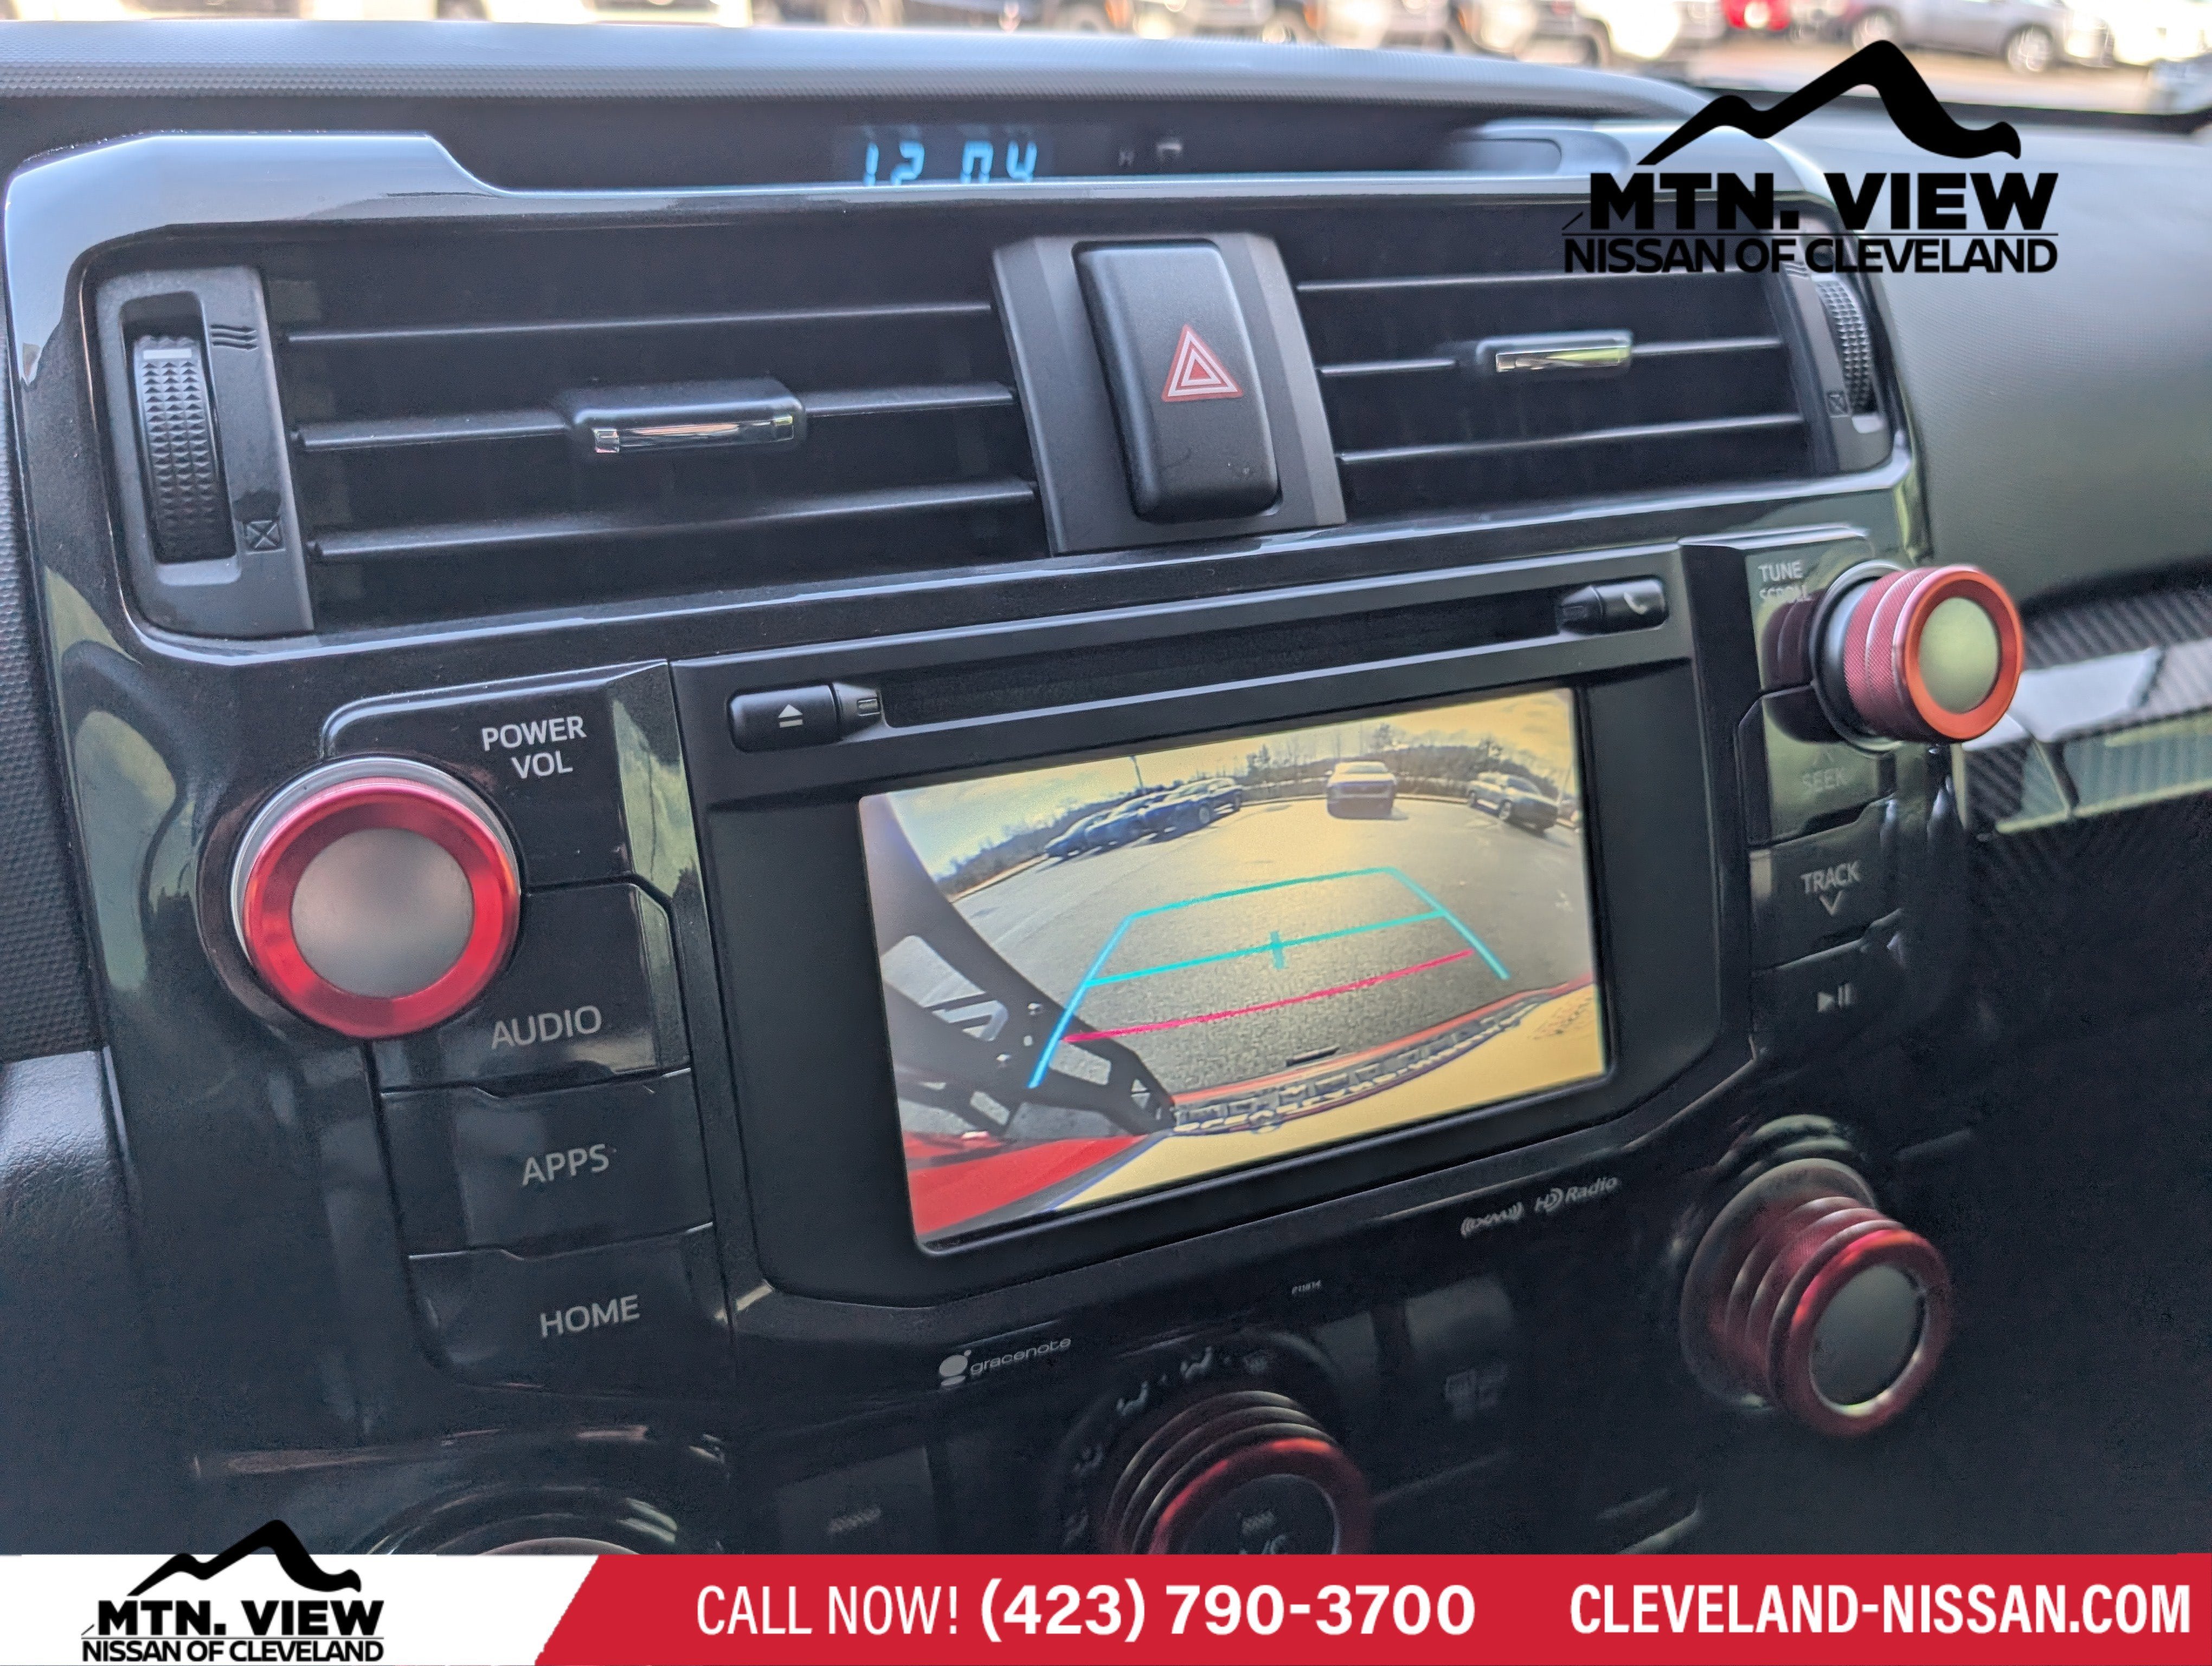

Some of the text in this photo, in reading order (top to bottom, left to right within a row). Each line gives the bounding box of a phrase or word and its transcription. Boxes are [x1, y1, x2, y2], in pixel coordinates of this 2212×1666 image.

[1758, 560, 1803, 582] TUNE
[481, 715, 587, 751] POWER
[512, 752, 573, 779] VOL
[1801, 861, 1861, 895] TRACK
[491, 1005, 602, 1049] AUDIO
[522, 1143, 610, 1187] APPS
[1565, 1176, 1618, 1203] Radio
[539, 1295, 641, 1338] HOME
[970, 1337, 1071, 1376] gracenote
